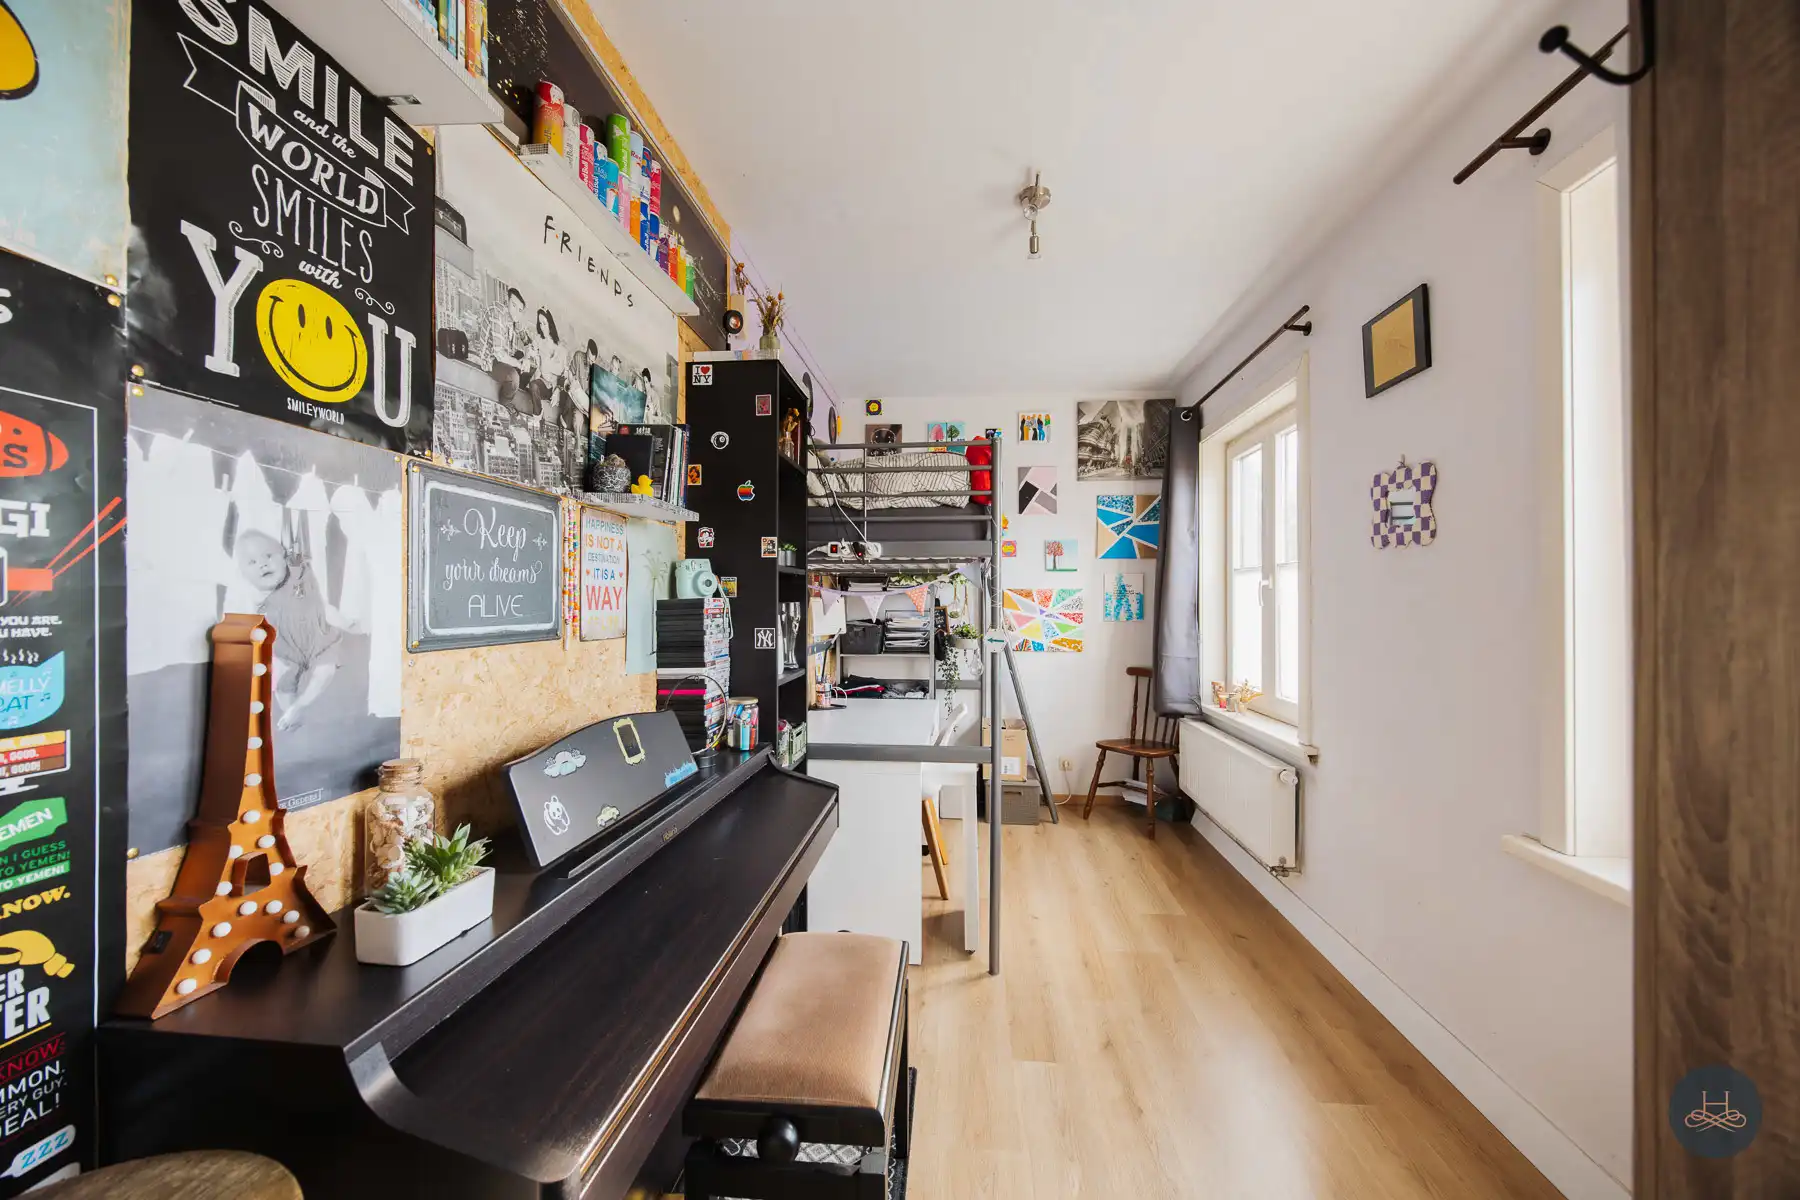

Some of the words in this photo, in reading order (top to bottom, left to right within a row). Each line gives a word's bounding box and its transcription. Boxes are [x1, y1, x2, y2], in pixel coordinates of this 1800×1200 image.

[178, 0, 414, 186] SMILE
[293, 109, 330, 140] and
[332, 132, 357, 159] the
[248, 102, 380, 216] WORLD
[252, 164, 373, 284] SMILES
[298, 259, 343, 290] with
[693, 375, 712, 384] NY
[695, 366, 700, 375] I
[286, 397, 346, 425] SMILEYWORLD
[463, 507, 527, 562] Keep
[585, 518, 624, 535] HAPPINESS
[596, 535, 615, 551] NOT
[616, 539, 624, 552] A
[442, 558, 485, 591] your
[489, 557, 543, 584] dreams
[593, 568, 600, 580] IT
[601, 568, 609, 580] IS
[610, 569, 616, 581] A
[468, 594, 524, 618] ALIVE
[585, 585, 623, 611] WAY
[0, 615, 29, 626] YOU
[11, 627, 52, 638] HAVE.
[21, 840, 67, 859] GUESS
[0, 885, 71, 919] NOW.
[0, 986, 50, 1040] ER
[0, 1092, 60, 1138] EAL!
